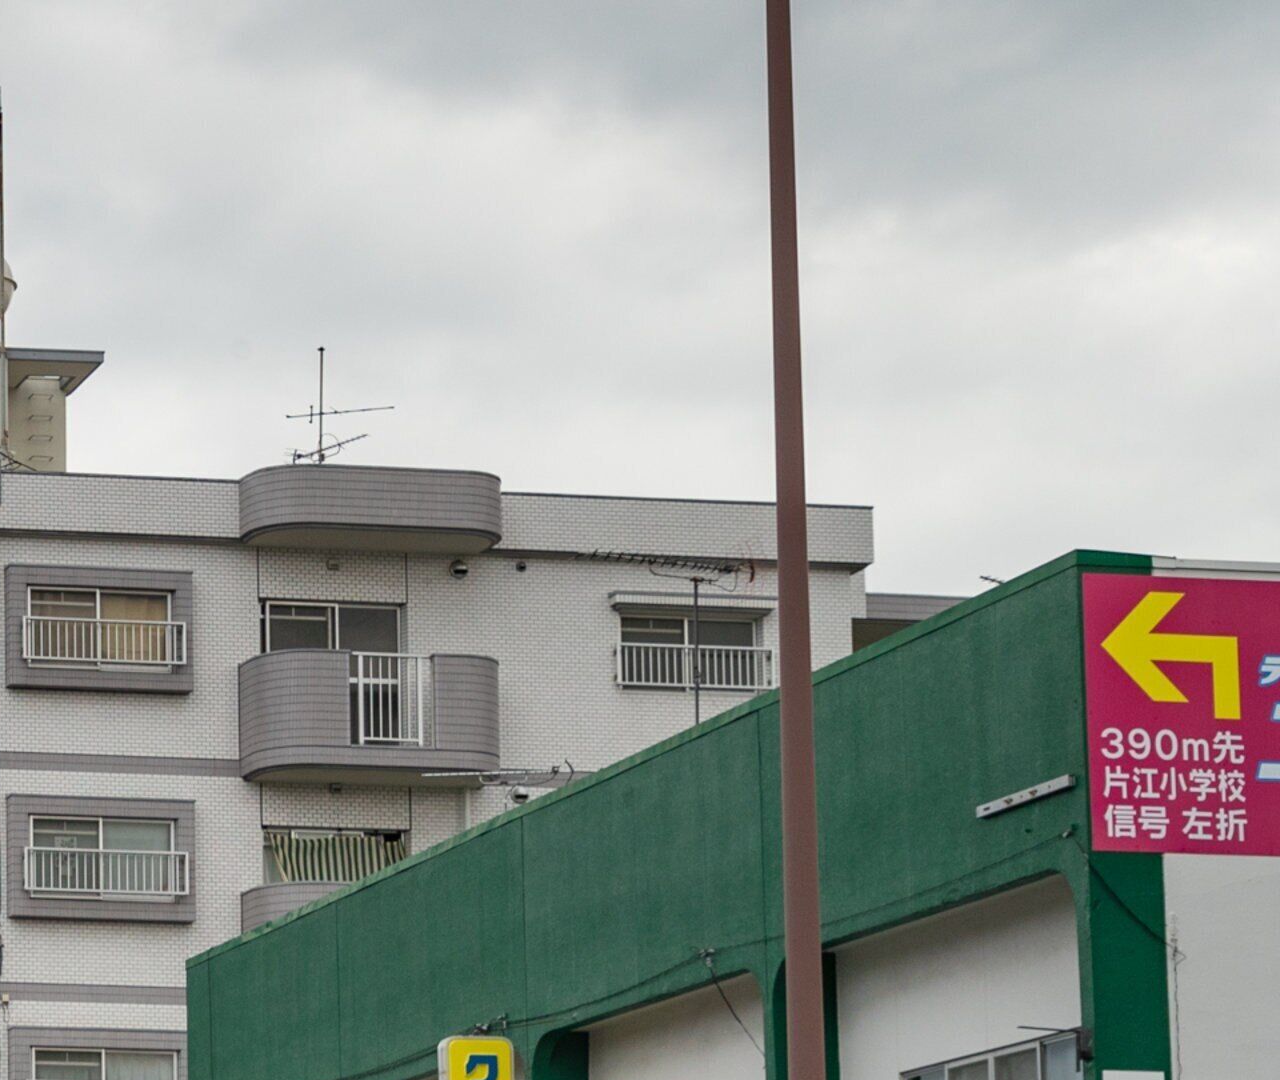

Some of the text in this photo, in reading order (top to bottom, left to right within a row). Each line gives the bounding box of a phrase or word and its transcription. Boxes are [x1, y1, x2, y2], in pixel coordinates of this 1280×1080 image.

[1100, 727, 1246, 765] 390m先
[1103, 765, 1247, 803] 片江小学校
[1104, 804, 1248, 842] 信号 左折
